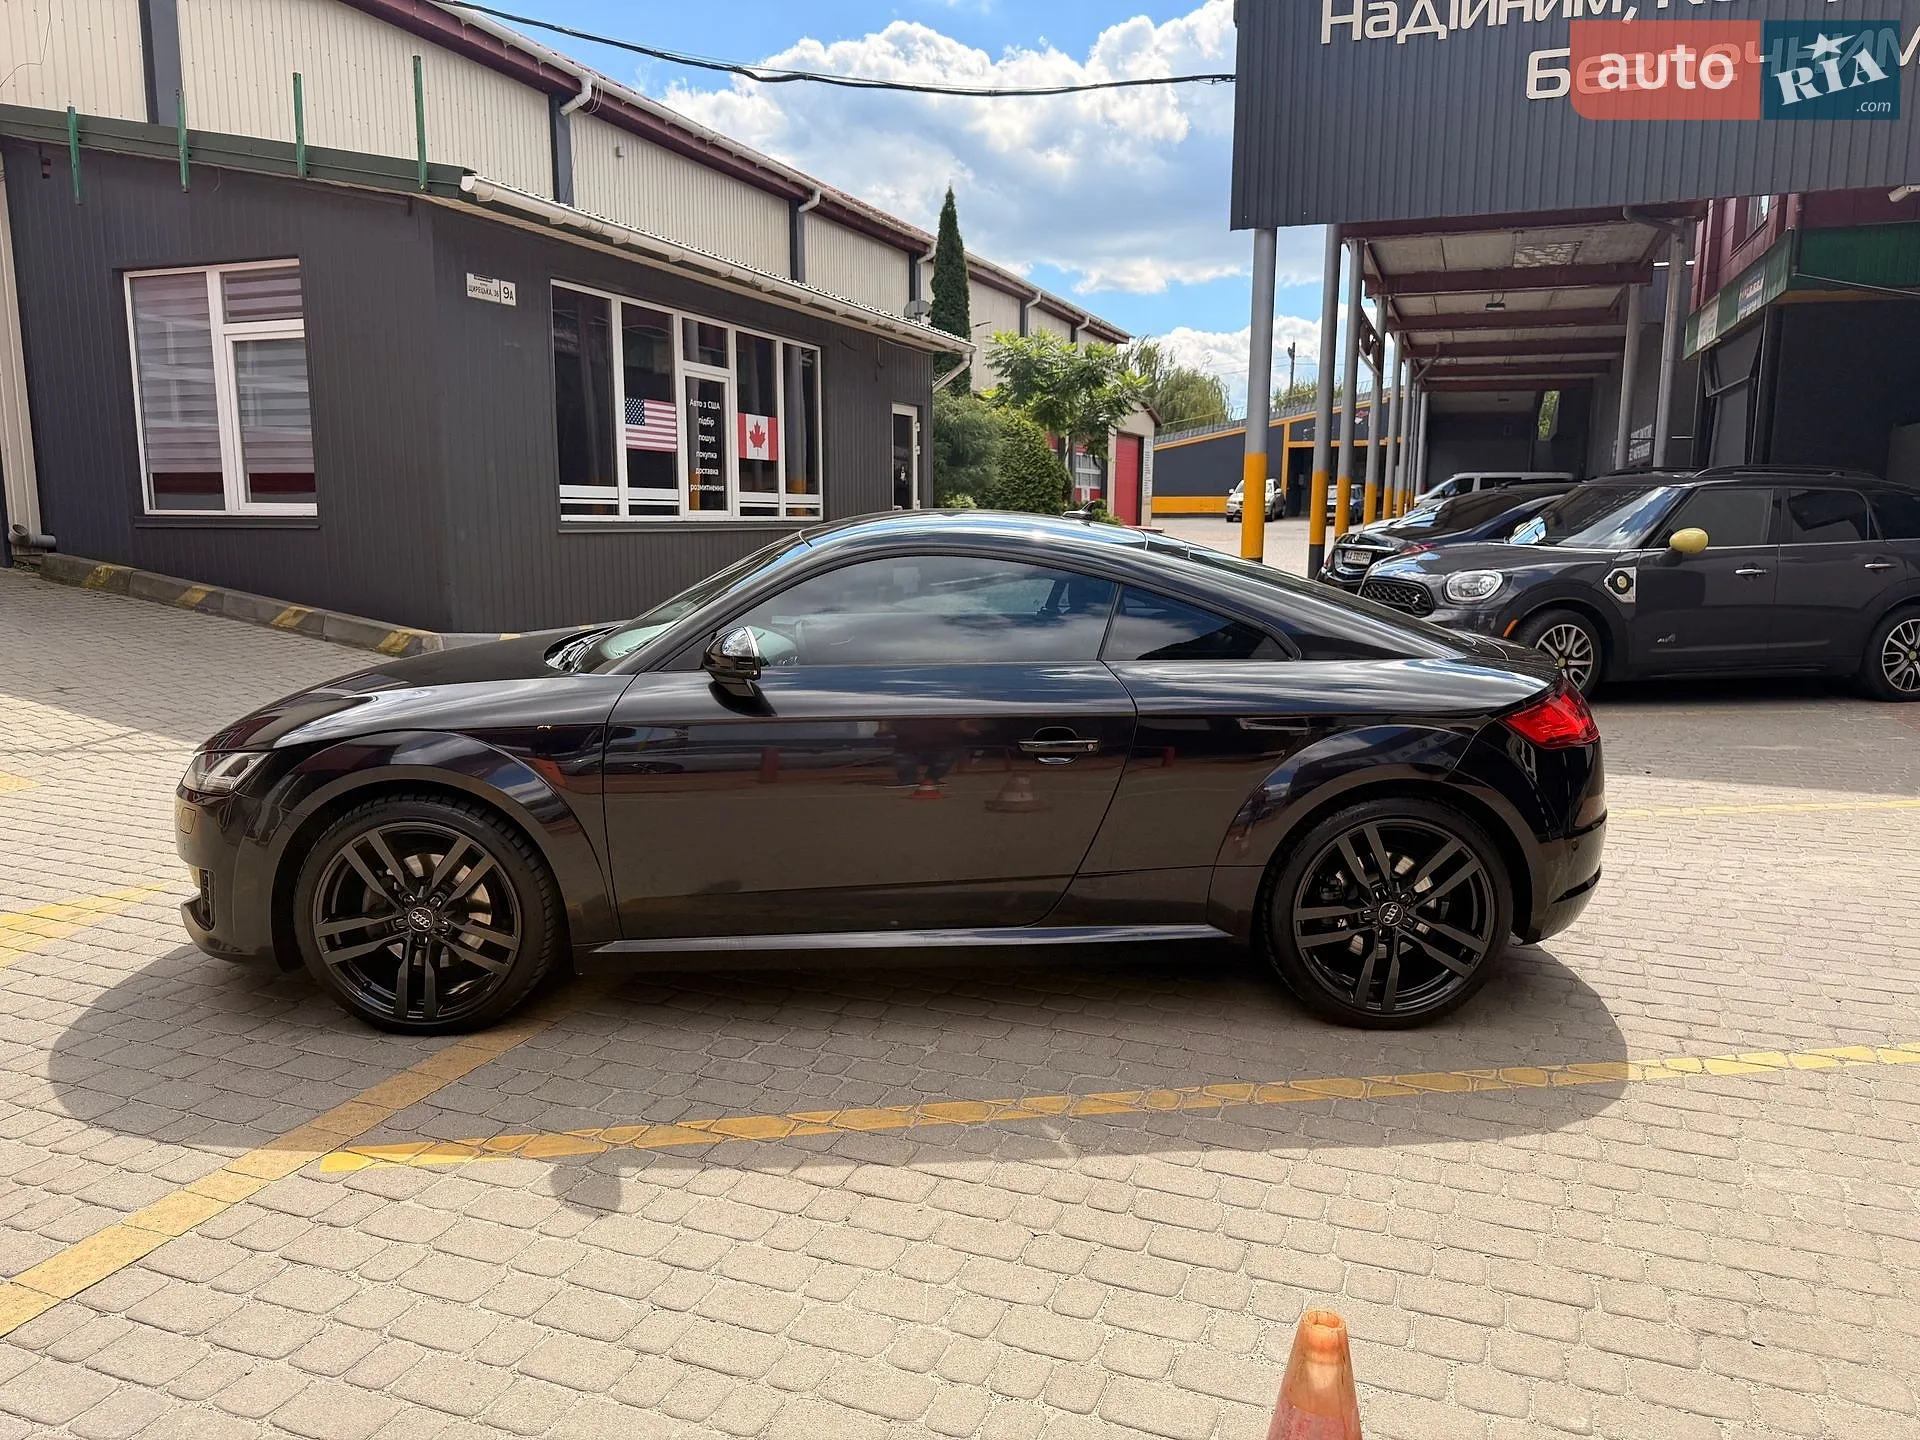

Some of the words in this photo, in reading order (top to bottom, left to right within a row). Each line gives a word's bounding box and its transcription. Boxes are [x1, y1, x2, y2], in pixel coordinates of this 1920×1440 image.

[689, 399, 702, 407] Авто
[708, 401, 720, 410] США
[698, 434, 716, 443] пошук
[696, 451, 718, 460] покупка
[696, 467, 719, 476] доставка
